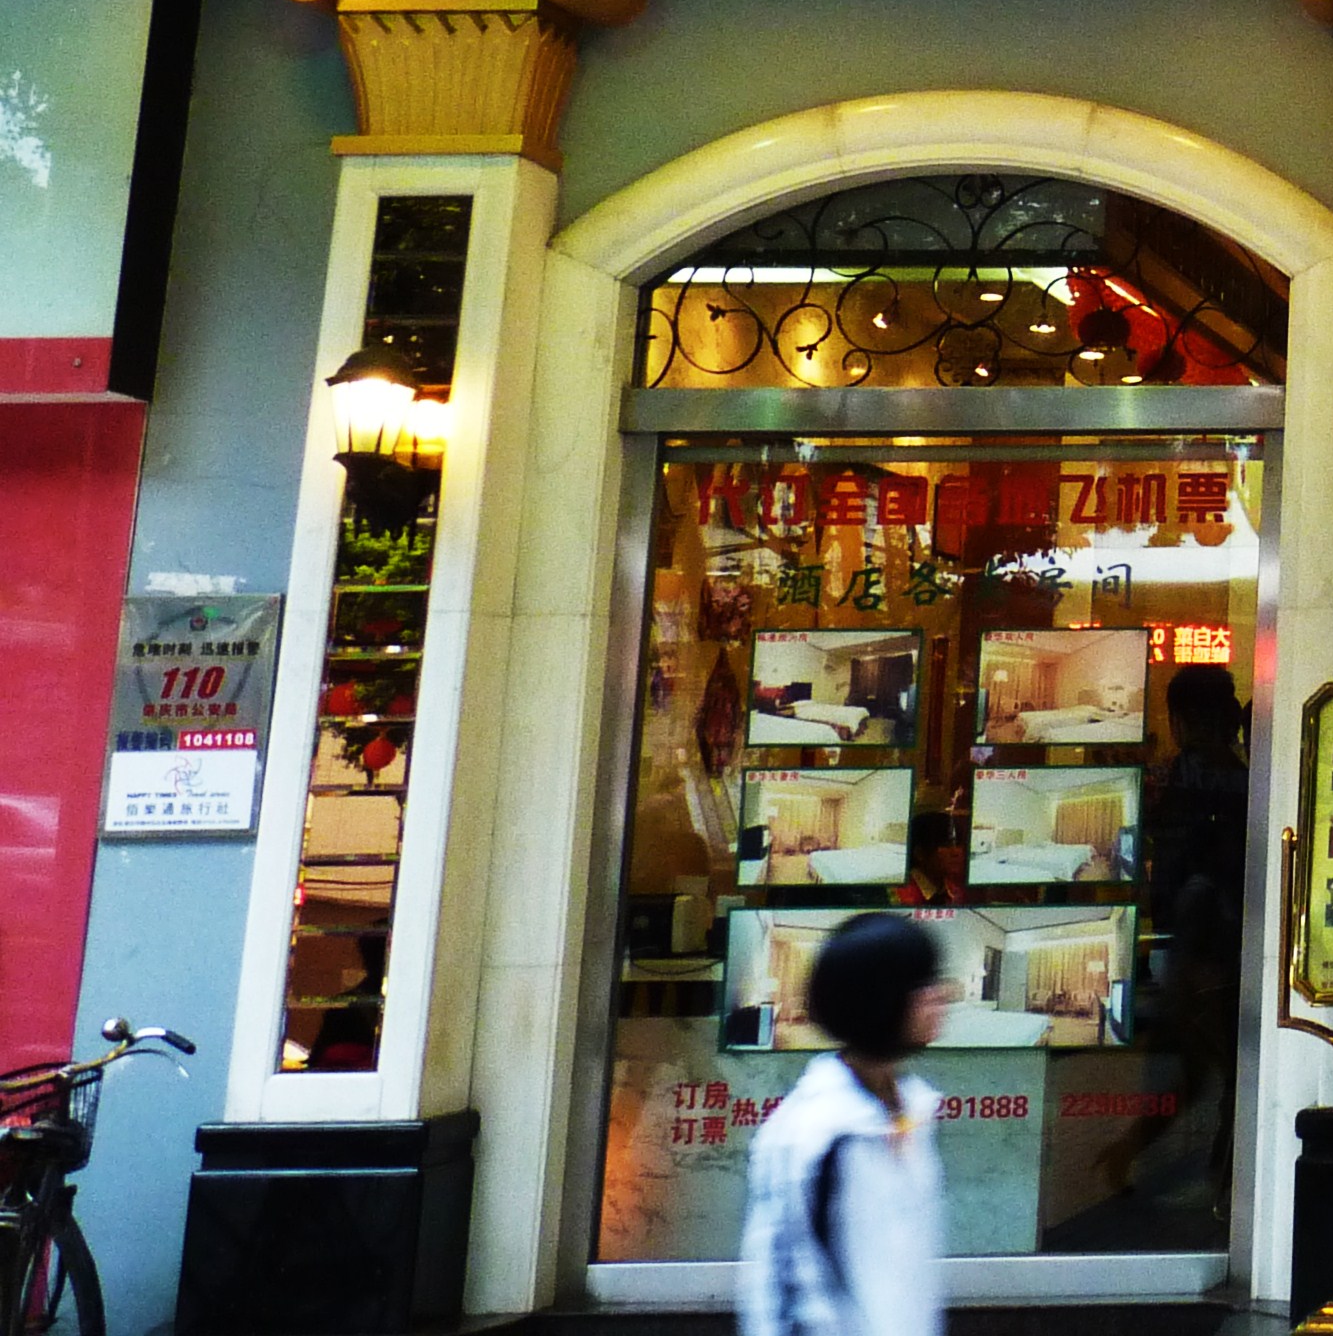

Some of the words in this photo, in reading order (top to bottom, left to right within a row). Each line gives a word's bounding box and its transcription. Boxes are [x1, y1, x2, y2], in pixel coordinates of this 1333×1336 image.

[777, 557, 1132, 611] 酒店各房间
[161, 666, 226, 700] 110
[184, 732, 254, 747] 1041108
[672, 1081, 730, 1112] 订房
[671, 1114, 728, 1145] 订票
